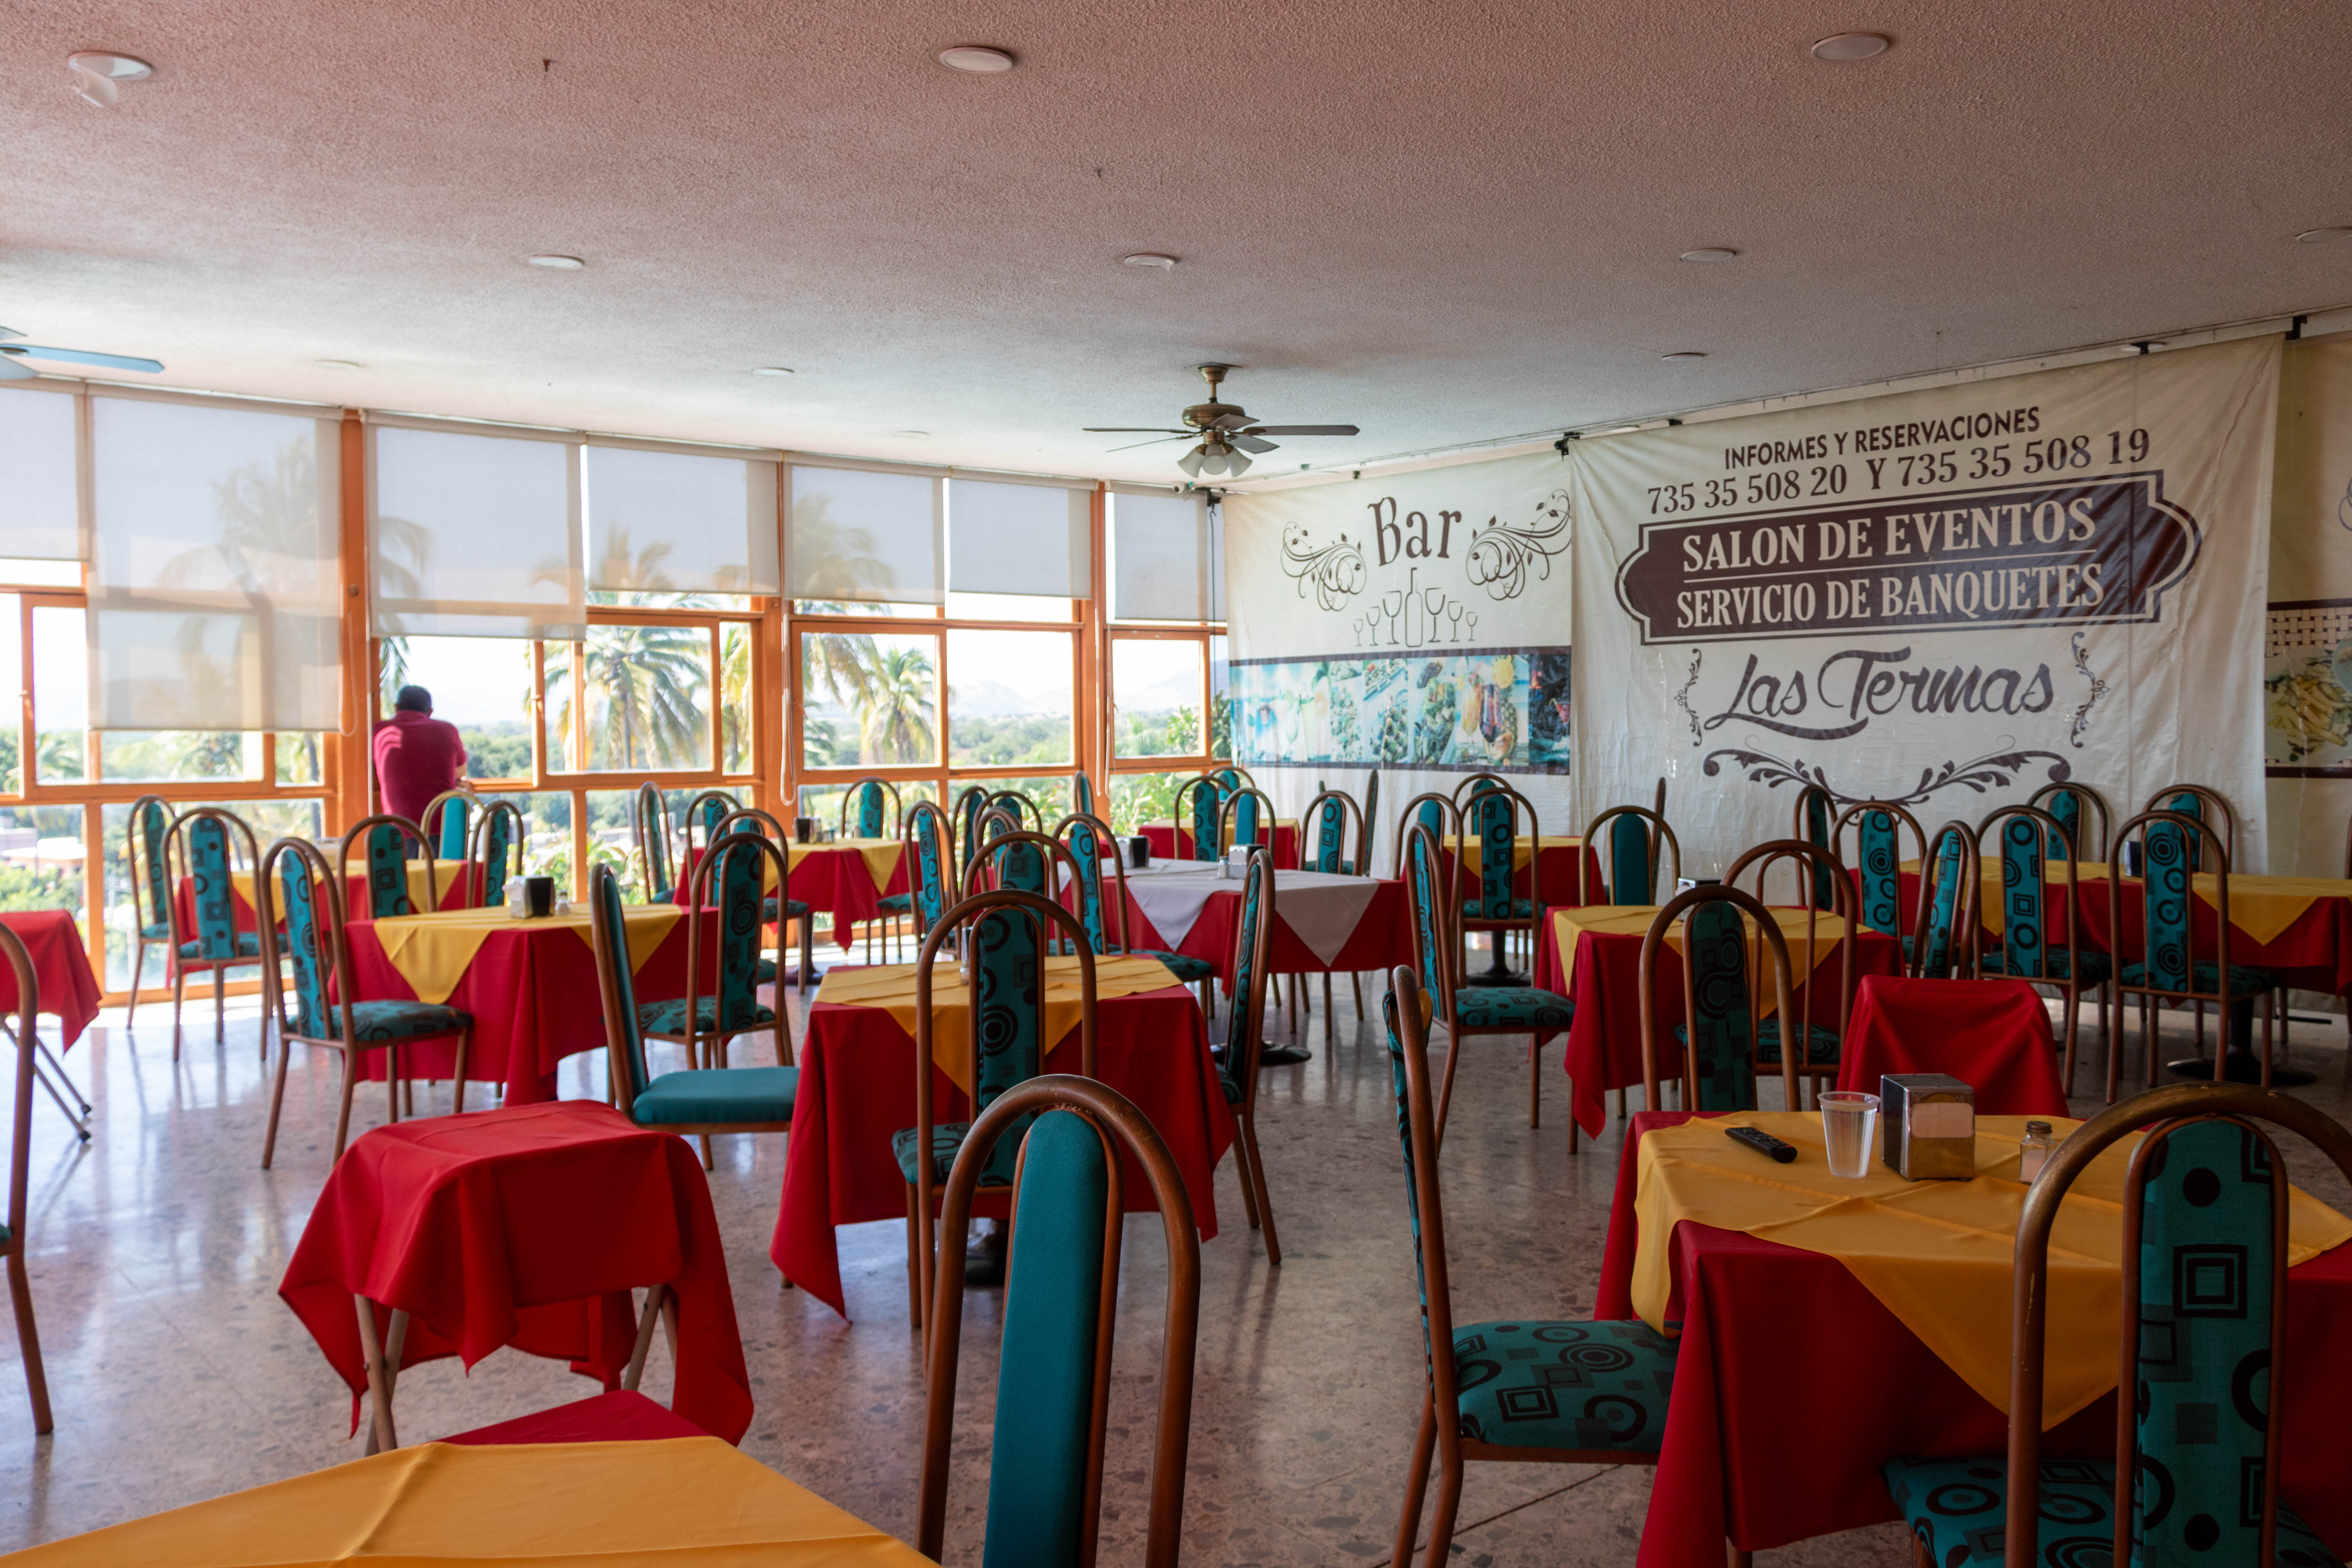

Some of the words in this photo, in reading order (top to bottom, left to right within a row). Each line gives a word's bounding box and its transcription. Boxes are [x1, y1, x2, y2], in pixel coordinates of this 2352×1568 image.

[1648, 483, 1695, 514] 735
[1704, 477, 1737, 508] 35
[1748, 470, 1800, 503] 508
[1811, 465, 1847, 496] 20
[1866, 458, 1887, 490] Y
[1898, 450, 1957, 486] 735
[1969, 444, 2011, 479] 35
[2024, 435, 2091, 473] 508
[2108, 428, 2149, 465] 19
[1725, 434, 1827, 469] INFORMES
[1834, 432, 1848, 455] Y
[1855, 407, 2040, 453] RESERVACIONES
[1368, 496, 1461, 567] Bar
[1683, 524, 1806, 572] SALON
[1818, 518, 1873, 561] DE
[1885, 498, 2096, 555] EVENTOS
[1677, 583, 1816, 628] SERVICIO
[1827, 579, 1871, 619] DE
[1881, 563, 2104, 619] BANQUETES
[1704, 653, 1868, 740] Las
[1818, 646, 2054, 720] Termas
